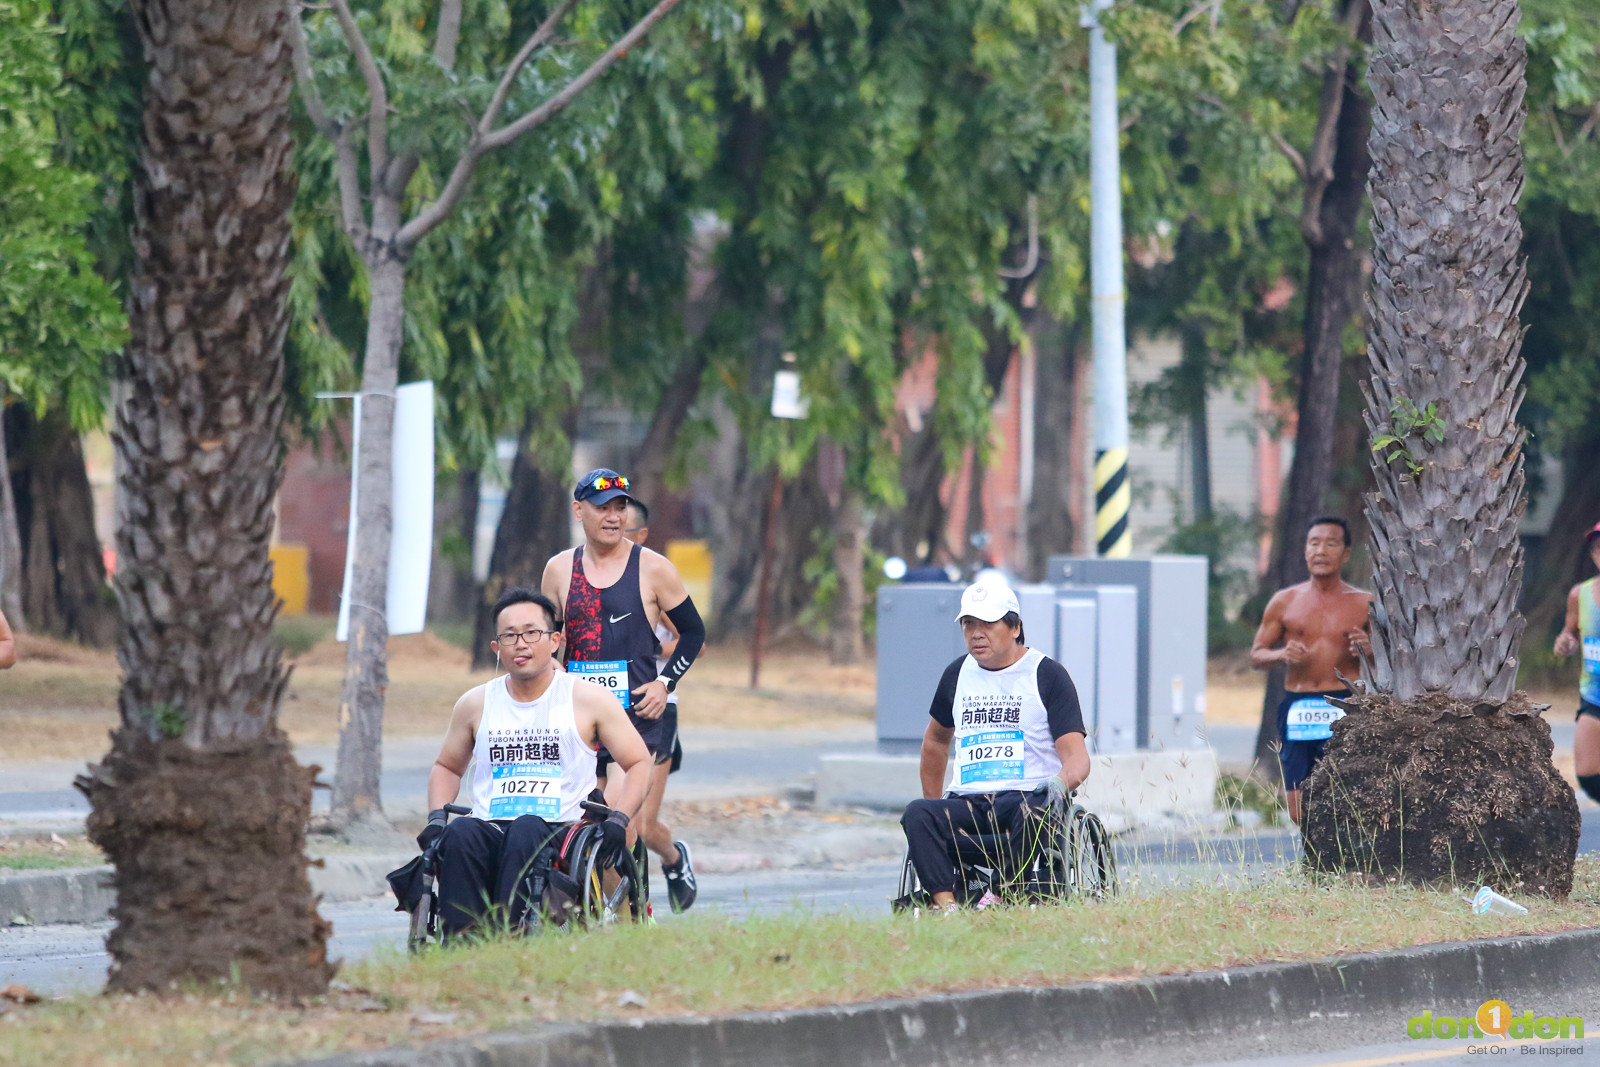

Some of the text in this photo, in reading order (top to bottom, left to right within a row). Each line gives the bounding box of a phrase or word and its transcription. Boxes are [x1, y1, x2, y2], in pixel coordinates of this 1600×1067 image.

[582, 676, 618, 688] 686
[962, 708, 1020, 725] 向前超越
[489, 742, 560, 763] 向前超越
[968, 745, 1014, 761] 10278
[500, 780, 550, 794] 10277
